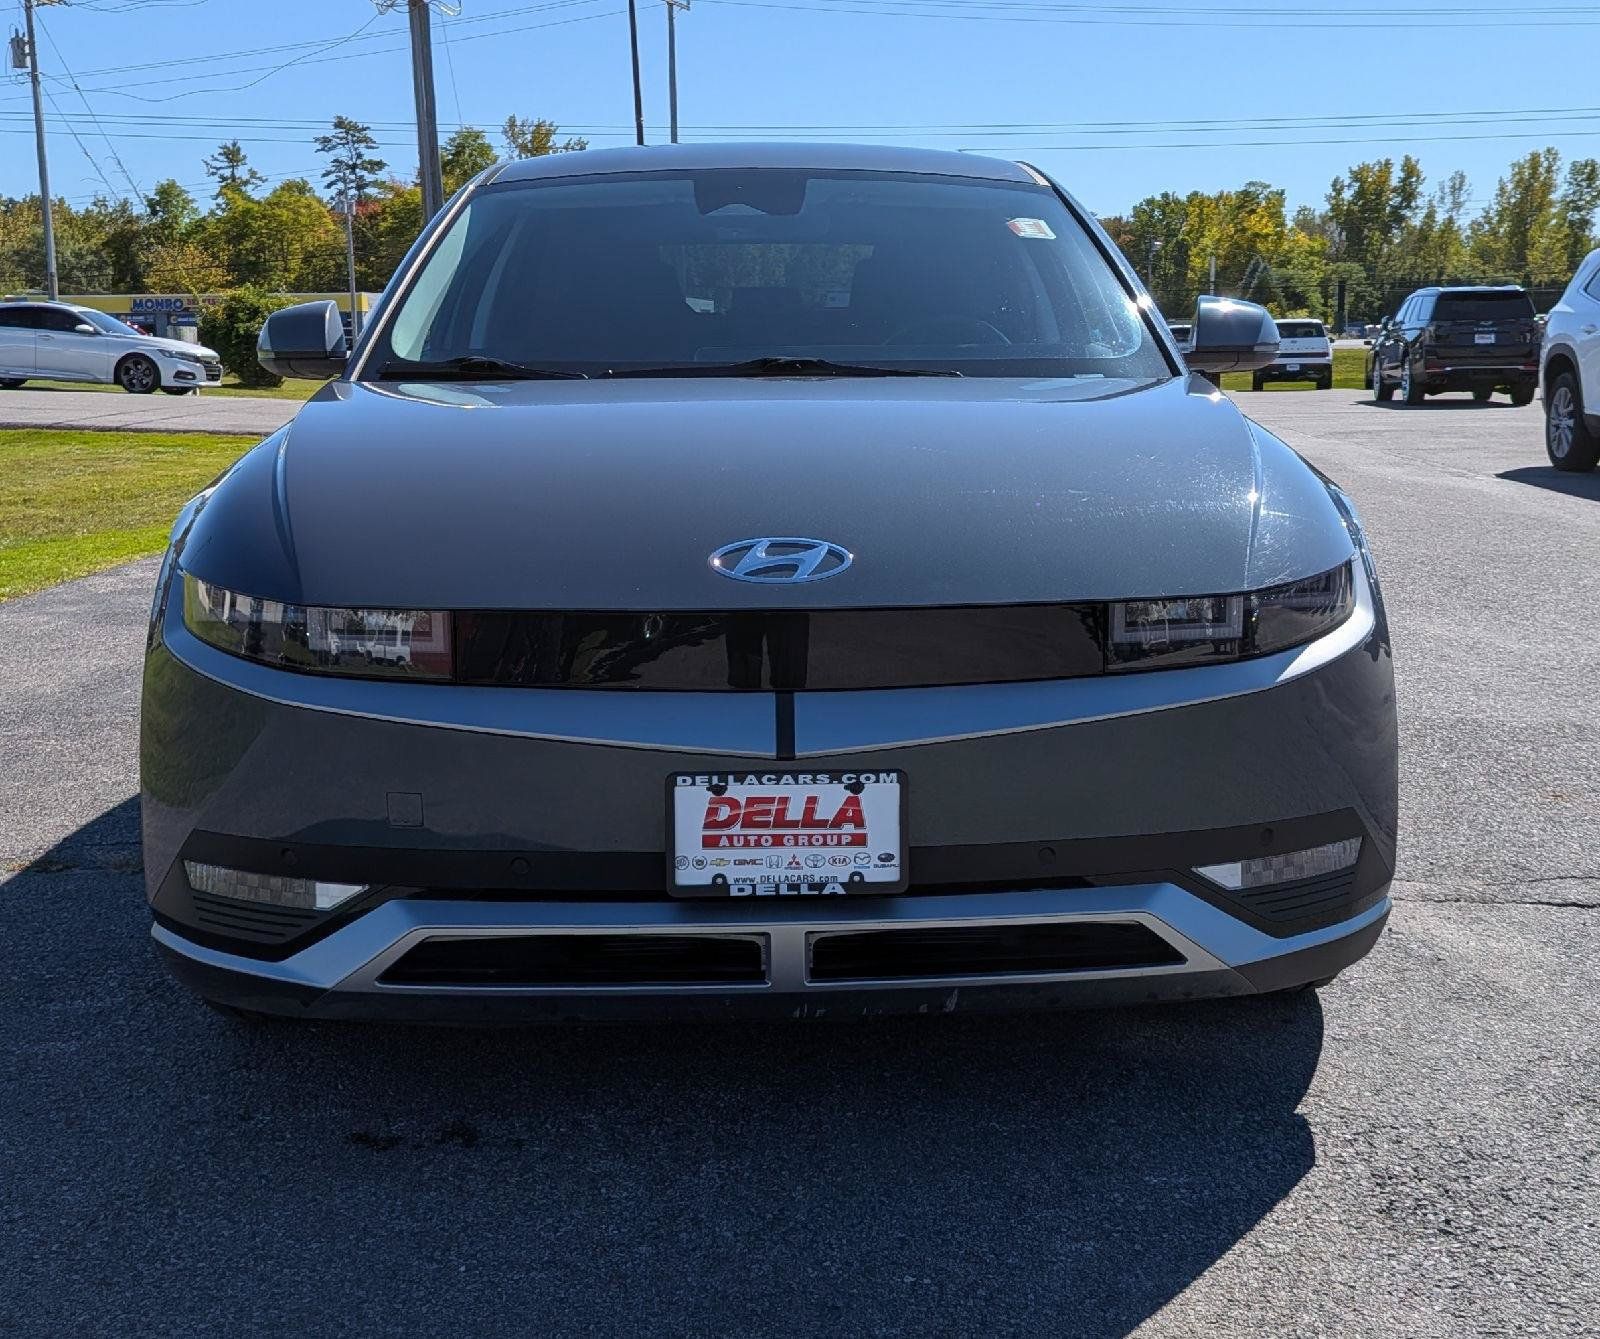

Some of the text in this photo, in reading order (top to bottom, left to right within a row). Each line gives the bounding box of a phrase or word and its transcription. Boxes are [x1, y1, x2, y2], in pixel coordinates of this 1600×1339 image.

[132, 298, 184, 312] MONRO
[676, 773, 898, 786] DELLACARS.COM
[702, 795, 868, 832] DELLA
[718, 834, 852, 847] AUTO GROUP
[733, 858, 764, 866] GMC
[832, 857, 847, 865] KIA
[733, 874, 838, 884] www.DELLACARS.com
[730, 884, 846, 896] DELLA
